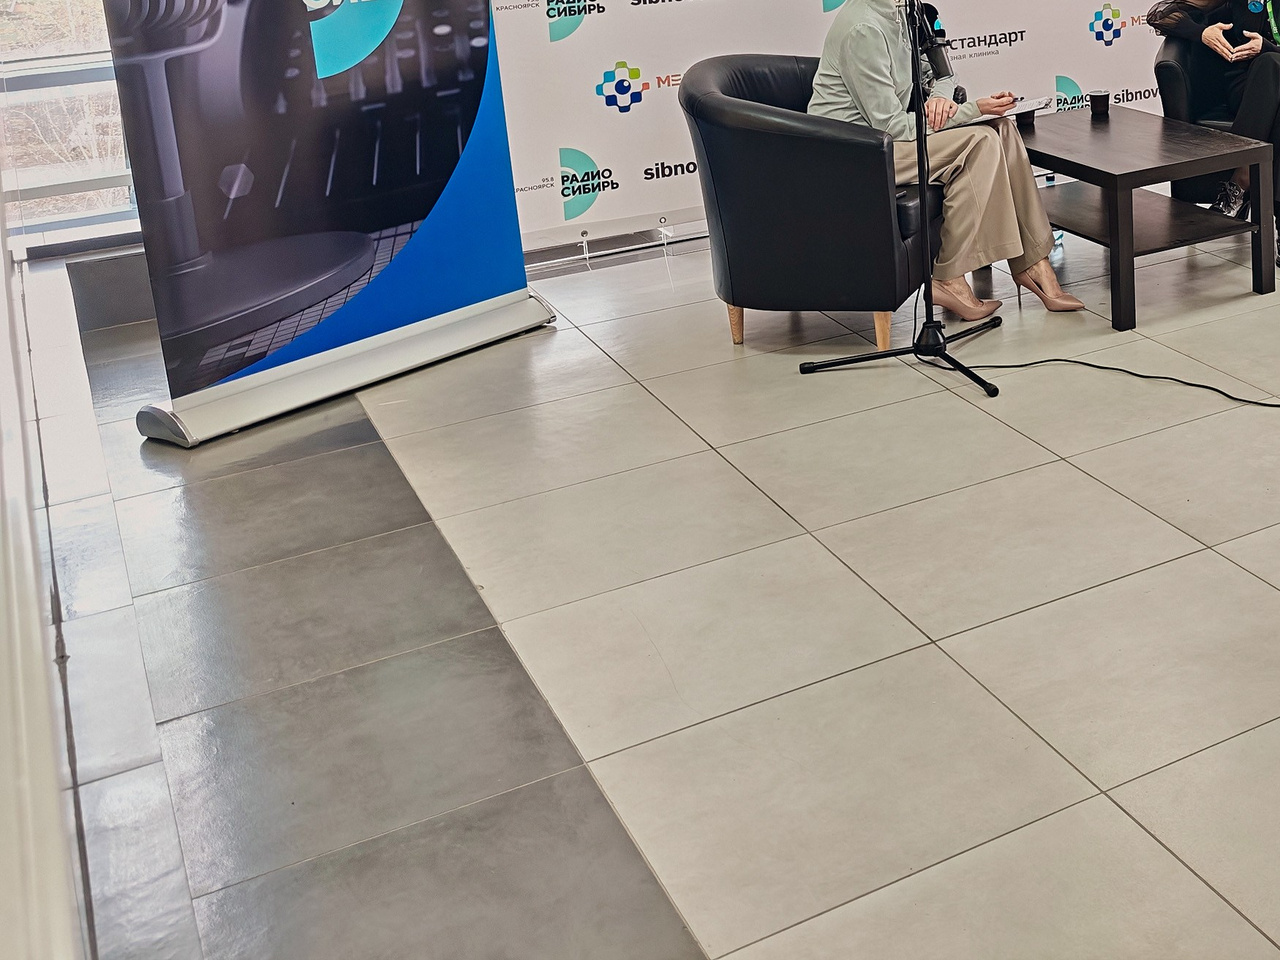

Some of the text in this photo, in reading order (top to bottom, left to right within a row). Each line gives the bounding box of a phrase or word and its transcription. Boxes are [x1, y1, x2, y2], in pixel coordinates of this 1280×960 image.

[495, 3, 540, 12] КРАСНОЯРСК
[546, 3, 606, 19] СИБИРЬ
[949, 30, 1026, 51] стандарт
[969, 50, 1000, 58] клиника
[1056, 94, 1091, 107] РАДИО
[561, 168, 613, 186] РАДИО
[515, 183, 555, 193] РАСНОЯРСК
[560, 179, 620, 198] СИБИРЬ
